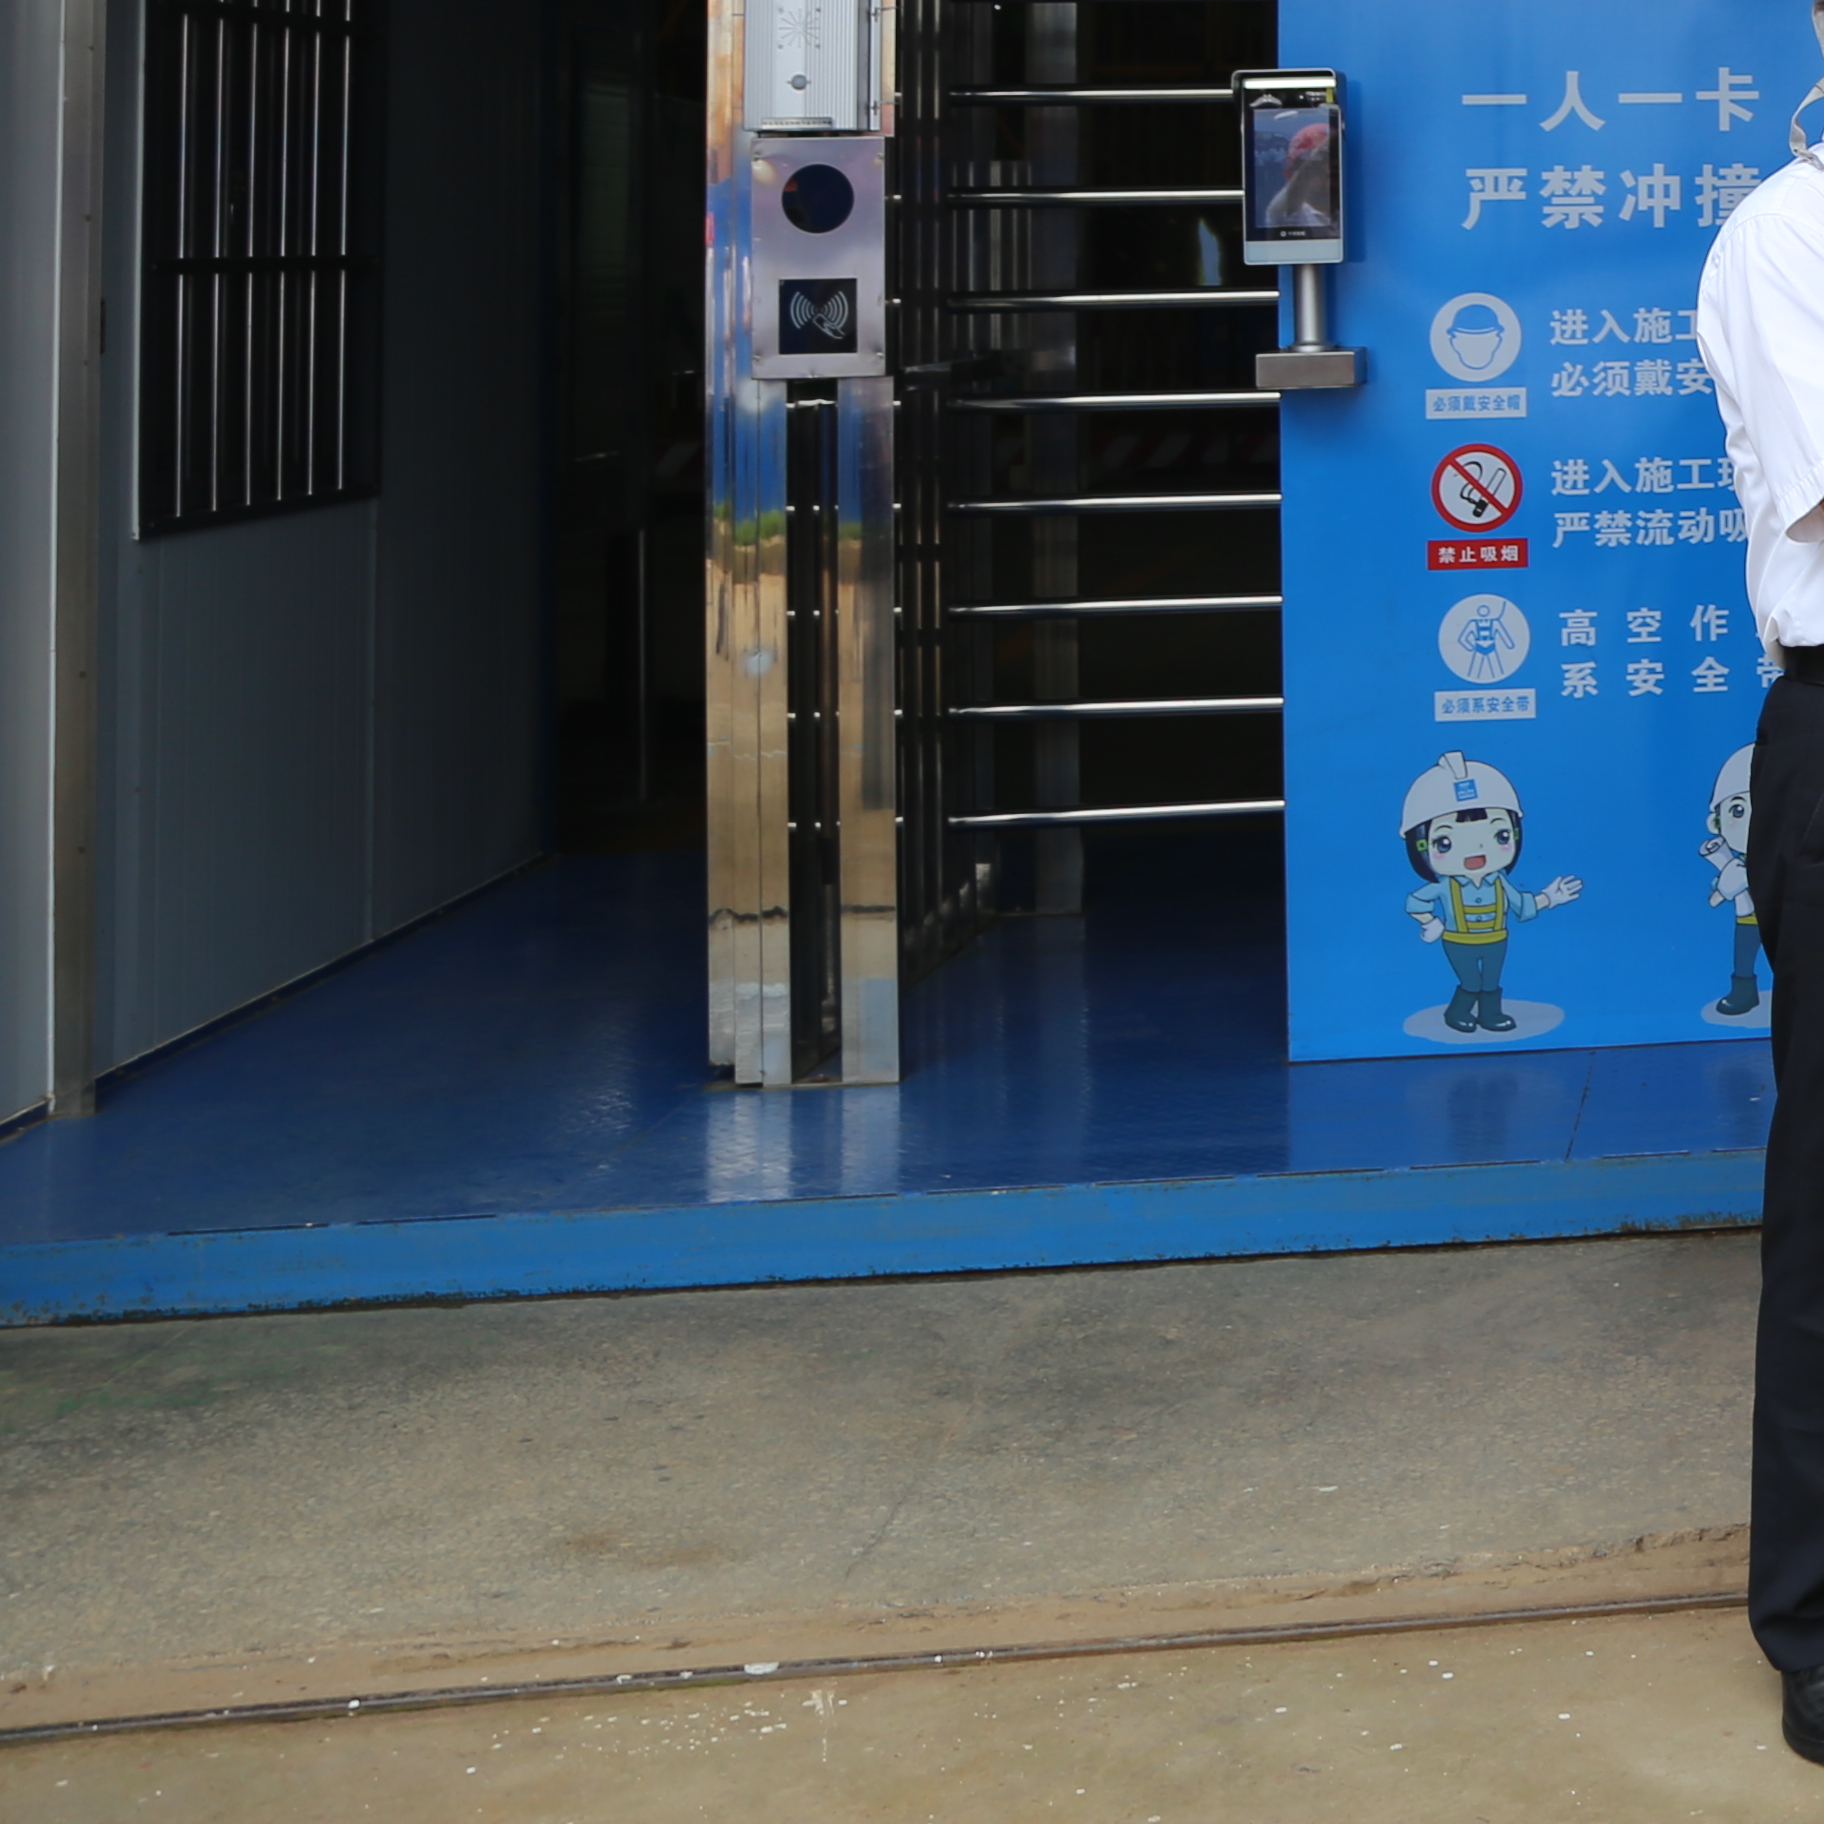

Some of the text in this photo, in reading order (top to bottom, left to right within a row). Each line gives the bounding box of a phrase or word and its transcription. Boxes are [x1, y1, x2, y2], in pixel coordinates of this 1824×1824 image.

[1461, 67, 1760, 132] 一人一卡
[1461, 163, 1763, 230] 严禁冲撞
[1432, 394, 1521, 413] 必须戴安全帽
[1438, 545, 1519, 564] 禁止吸烟
[1559, 604, 1762, 648] 高空作
[1441, 694, 1530, 715] 必须系安全带
